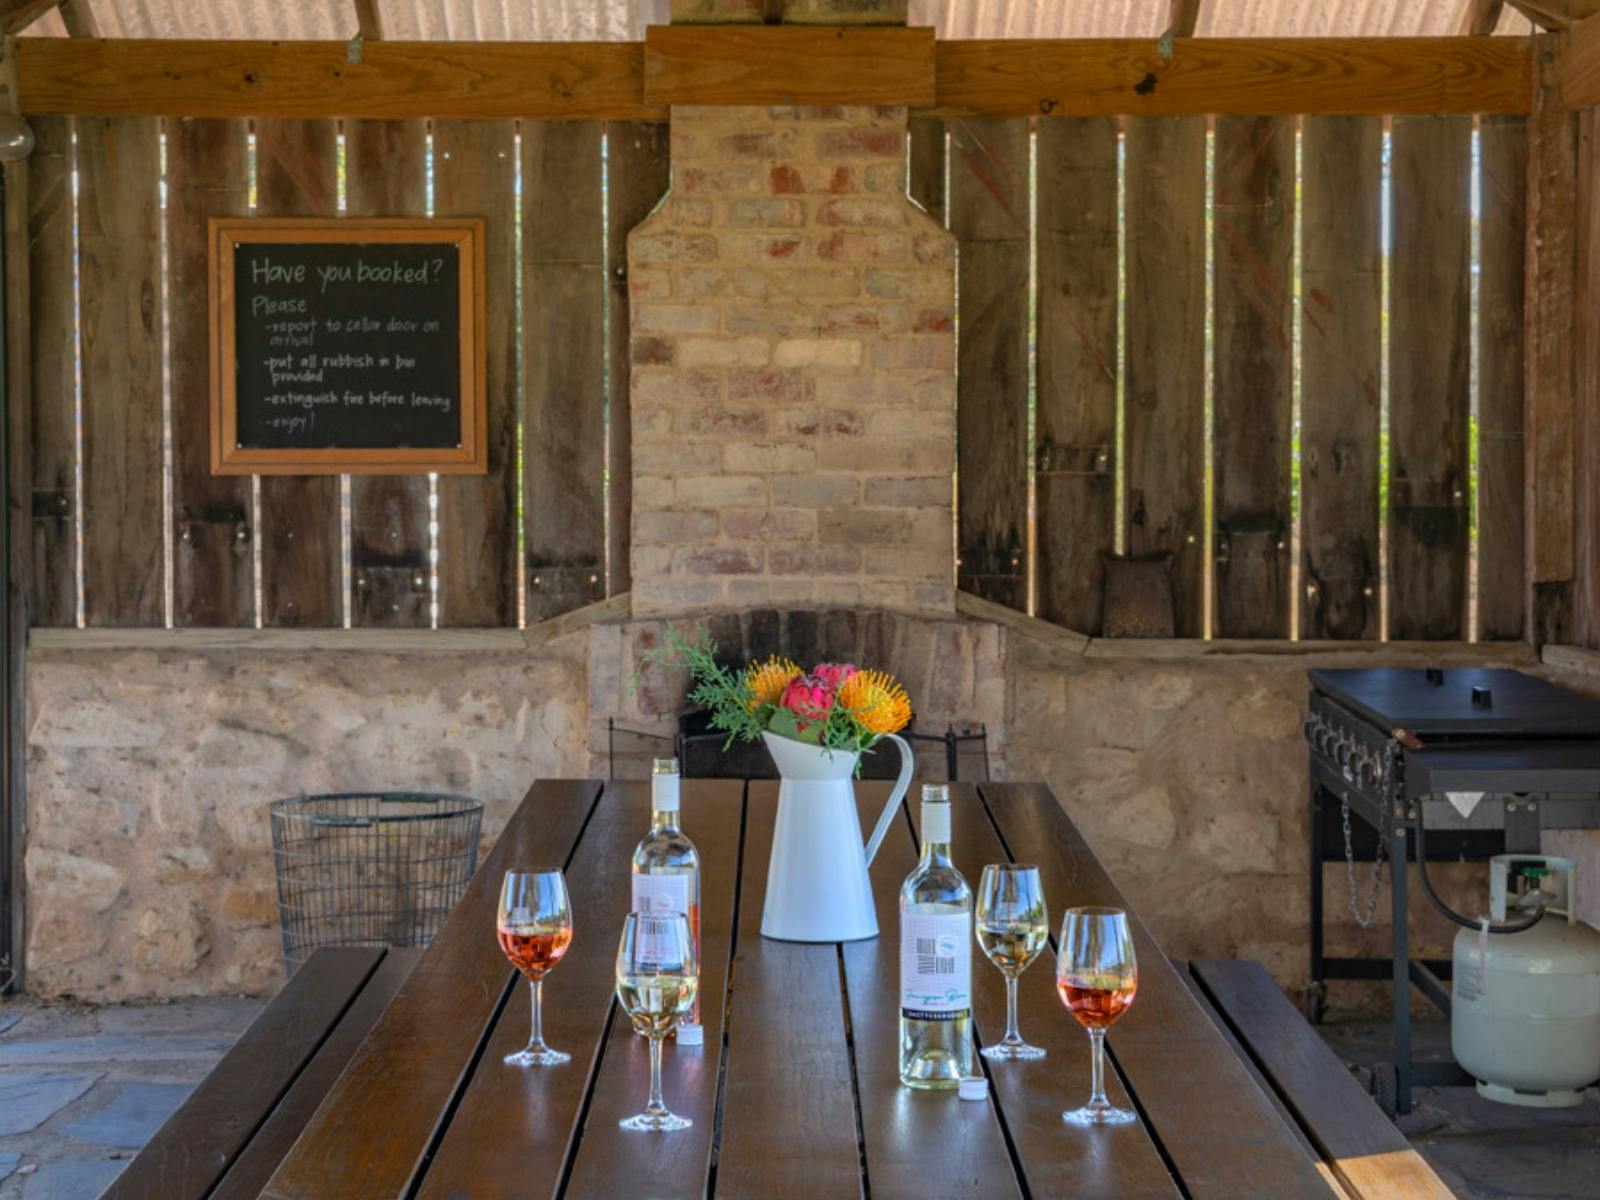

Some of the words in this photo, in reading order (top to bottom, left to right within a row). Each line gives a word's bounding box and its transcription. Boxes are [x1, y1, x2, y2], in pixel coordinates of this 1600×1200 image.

[252, 257, 305, 284] Have
[317, 265, 352, 294] you
[357, 258, 444, 285] booked?
[252, 294, 308, 317] Please
[325, 318, 340, 333] to
[386, 317, 418, 333] door
[422, 320, 439, 333] on
[300, 353, 318, 369] all
[322, 353, 374, 369] rubbish
[379, 354, 390, 368] in
[395, 354, 416, 371] bin
[272, 368, 324, 387] provided
[343, 390, 365, 407] fire
[369, 390, 405, 407] before
[411, 391, 451, 413] leaving
